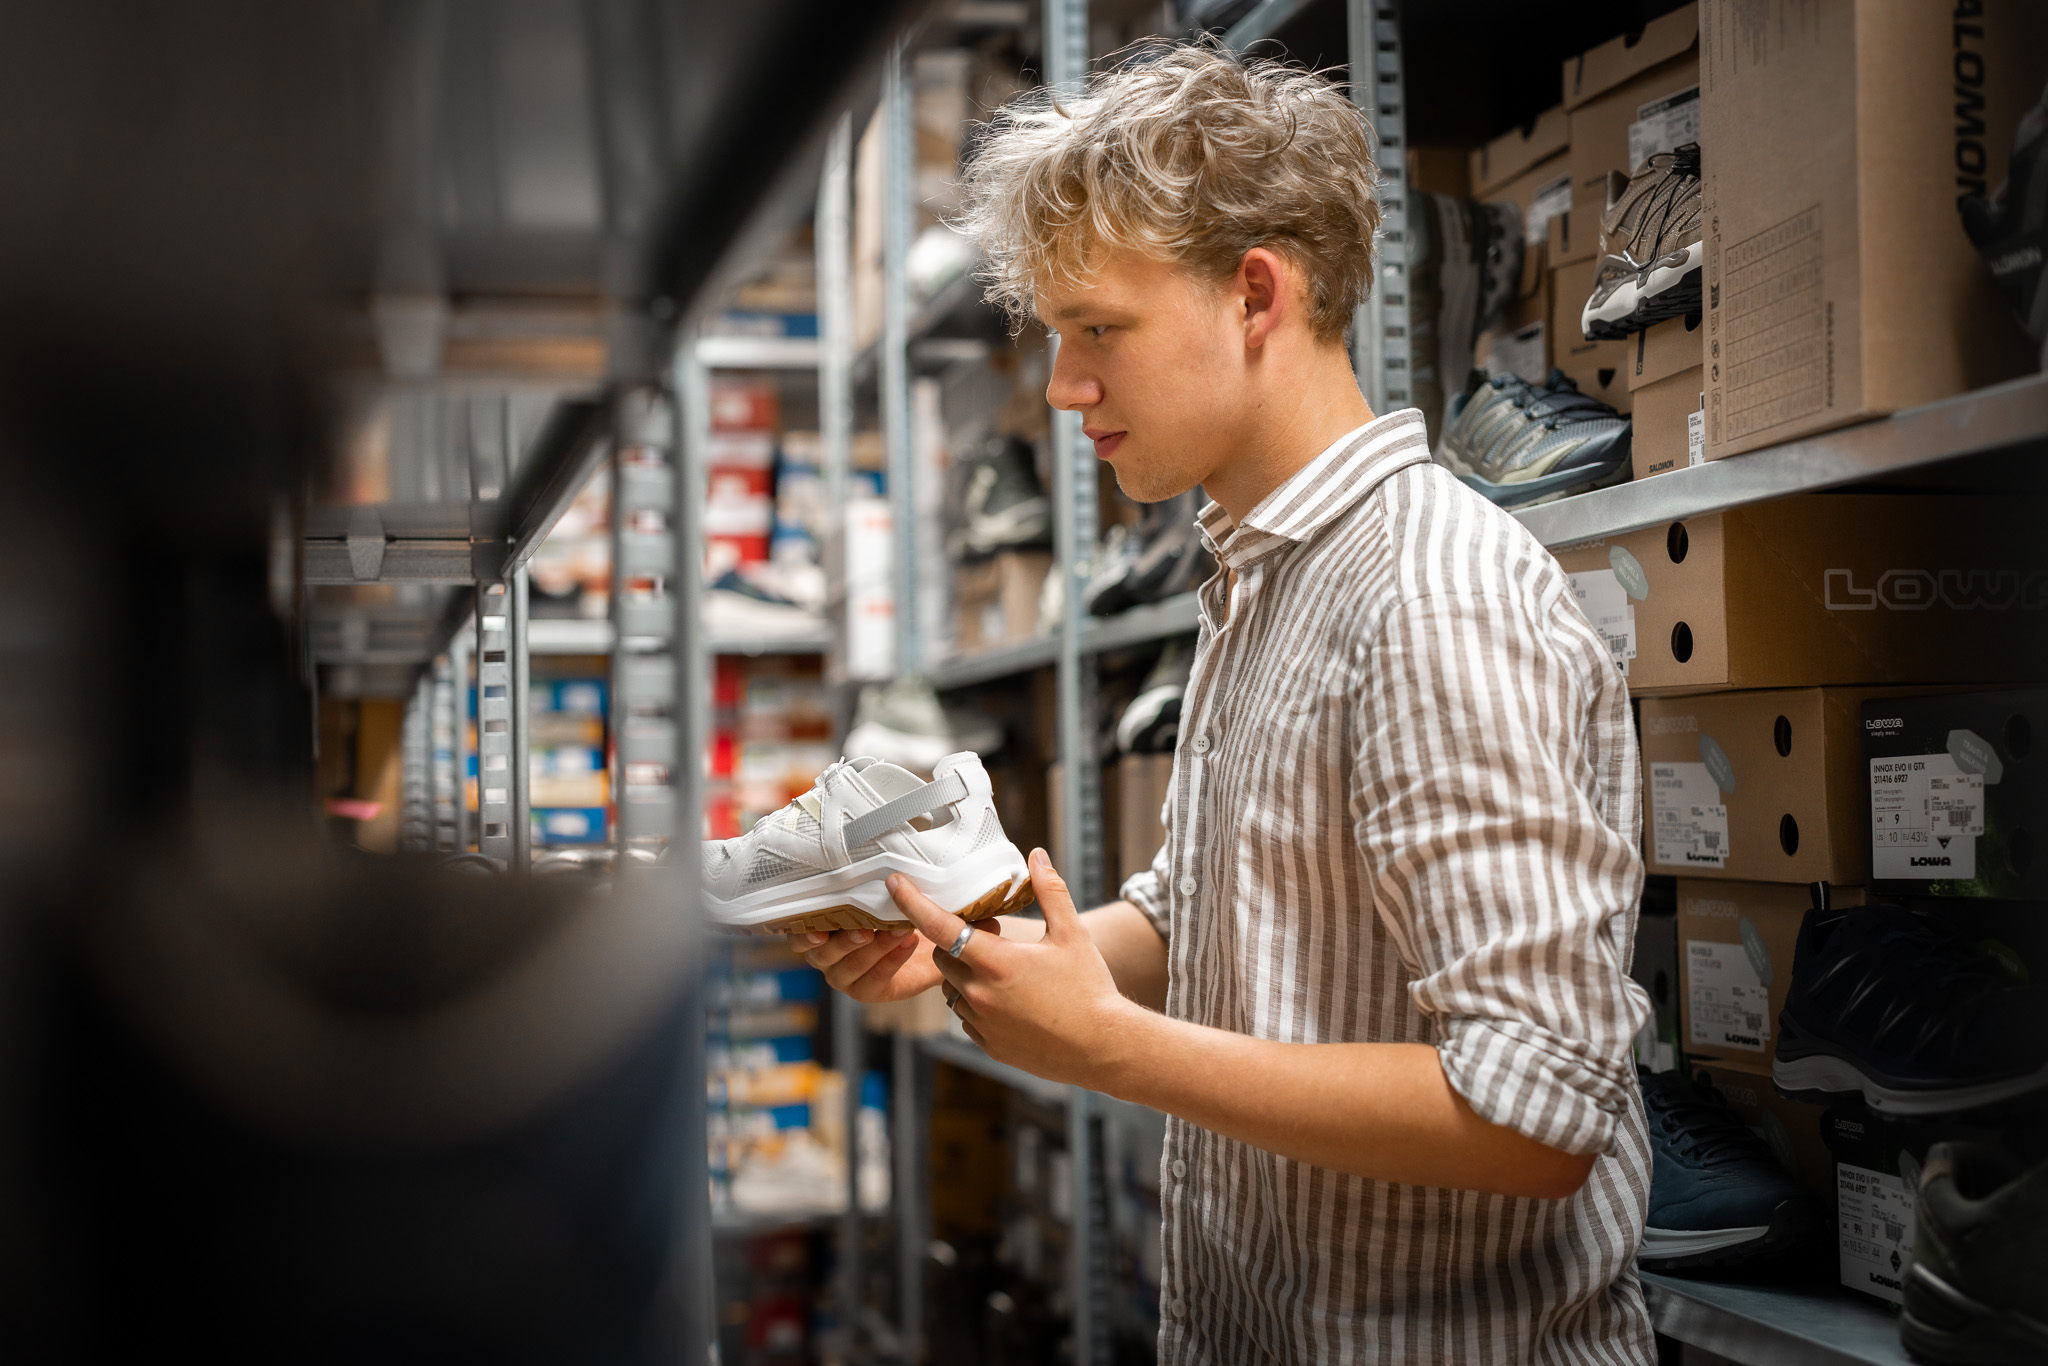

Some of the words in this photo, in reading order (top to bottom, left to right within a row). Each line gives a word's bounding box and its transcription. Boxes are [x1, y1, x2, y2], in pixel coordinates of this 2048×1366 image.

[1648, 458, 1675, 473] SALOMON
[1647, 715, 1698, 734] LOWA
[1866, 718, 1903, 729] LOWA
[1873, 763, 1894, 773] INNOX
[1894, 763, 1906, 772] EVO
[1908, 762, 1912, 771] II
[1913, 762, 1926, 771] GTX
[1873, 775, 1893, 784] 311416
[1894, 774, 1908, 783] 6927
[1894, 813, 1900, 824] 9
[1889, 832, 1898, 842] 10
[1903, 833, 1909, 841] EU
[1910, 857, 1951, 867] LOWA
[1725, 1033, 1760, 1046] LOWA
[1834, 1118, 1865, 1133] LOWA
[1839, 1169, 1855, 1180] INNOX
[1855, 1173, 1865, 1183] EVO
[1839, 1180, 1854, 1191] 311416
[1855, 1184, 1867, 1194] 6927
[1870, 1272, 1903, 1291] LOWA
